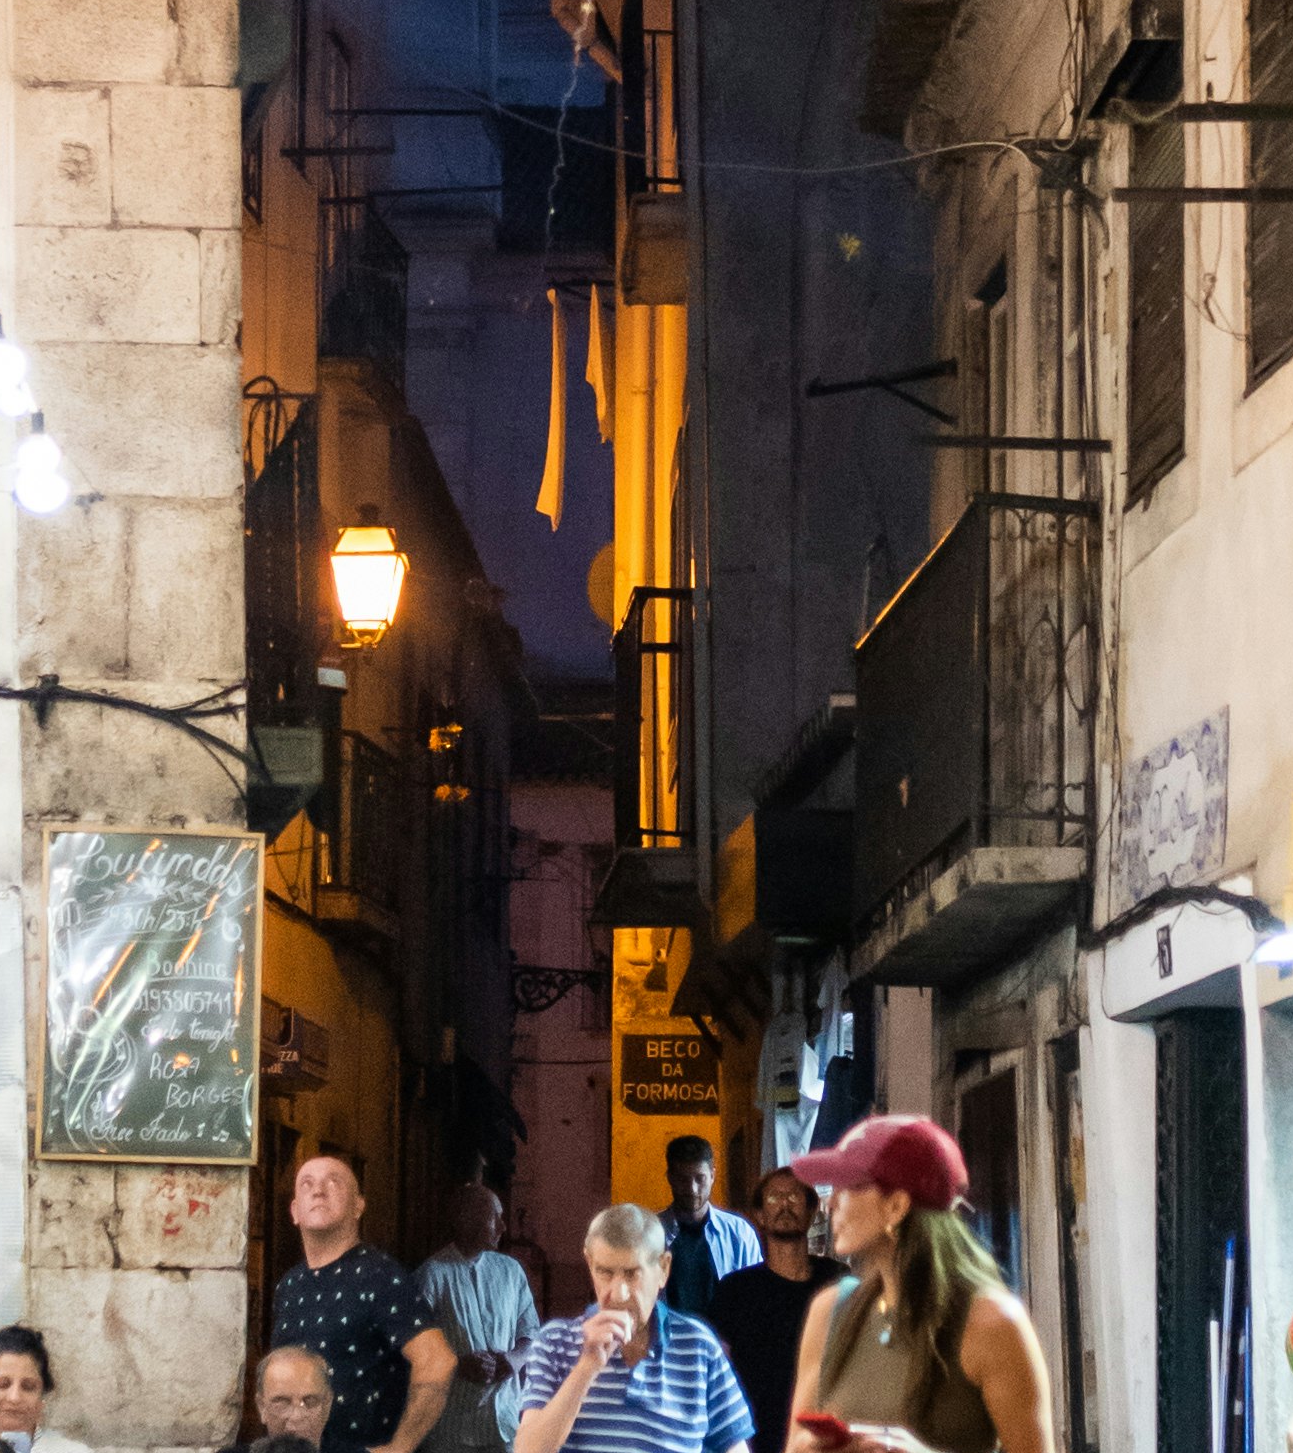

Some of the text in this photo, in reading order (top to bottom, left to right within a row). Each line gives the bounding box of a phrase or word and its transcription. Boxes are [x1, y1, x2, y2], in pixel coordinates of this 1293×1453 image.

[646, 1040, 700, 1058] BECO
[661, 1062, 683, 1077] DA
[165, 1082, 245, 1109] BORGES
[622, 1083, 718, 1102] FORMOSA
[90, 1108, 192, 1142] Free Fado
